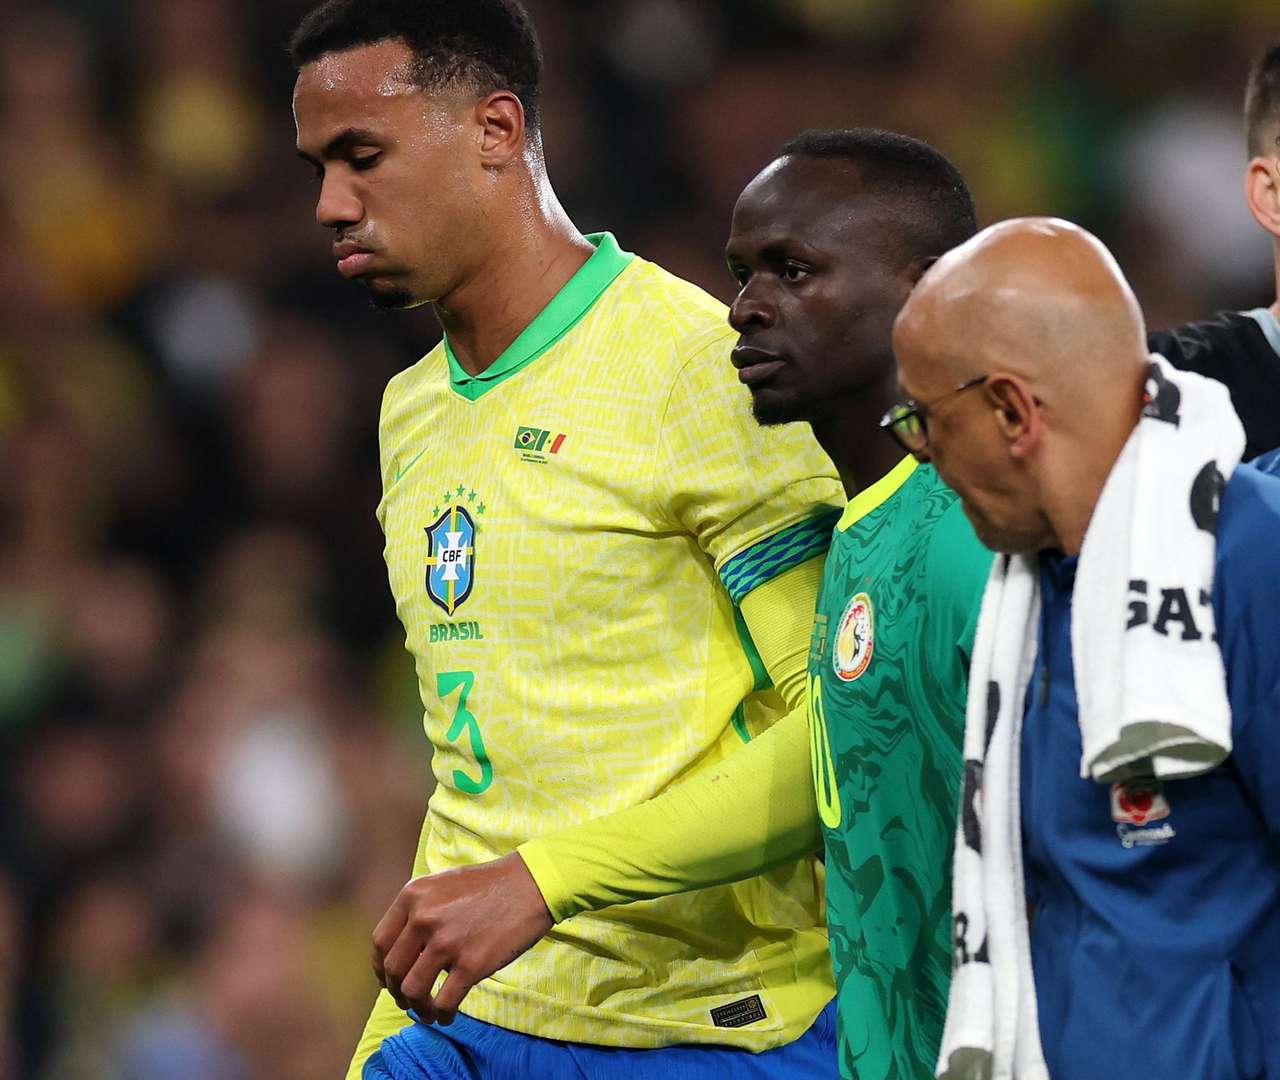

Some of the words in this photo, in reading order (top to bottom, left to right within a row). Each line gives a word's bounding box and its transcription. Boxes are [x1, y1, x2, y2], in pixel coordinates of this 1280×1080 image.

[442, 549, 462, 563] CBF
[429, 621, 484, 643] BRASIL
[436, 670, 494, 795] 3
